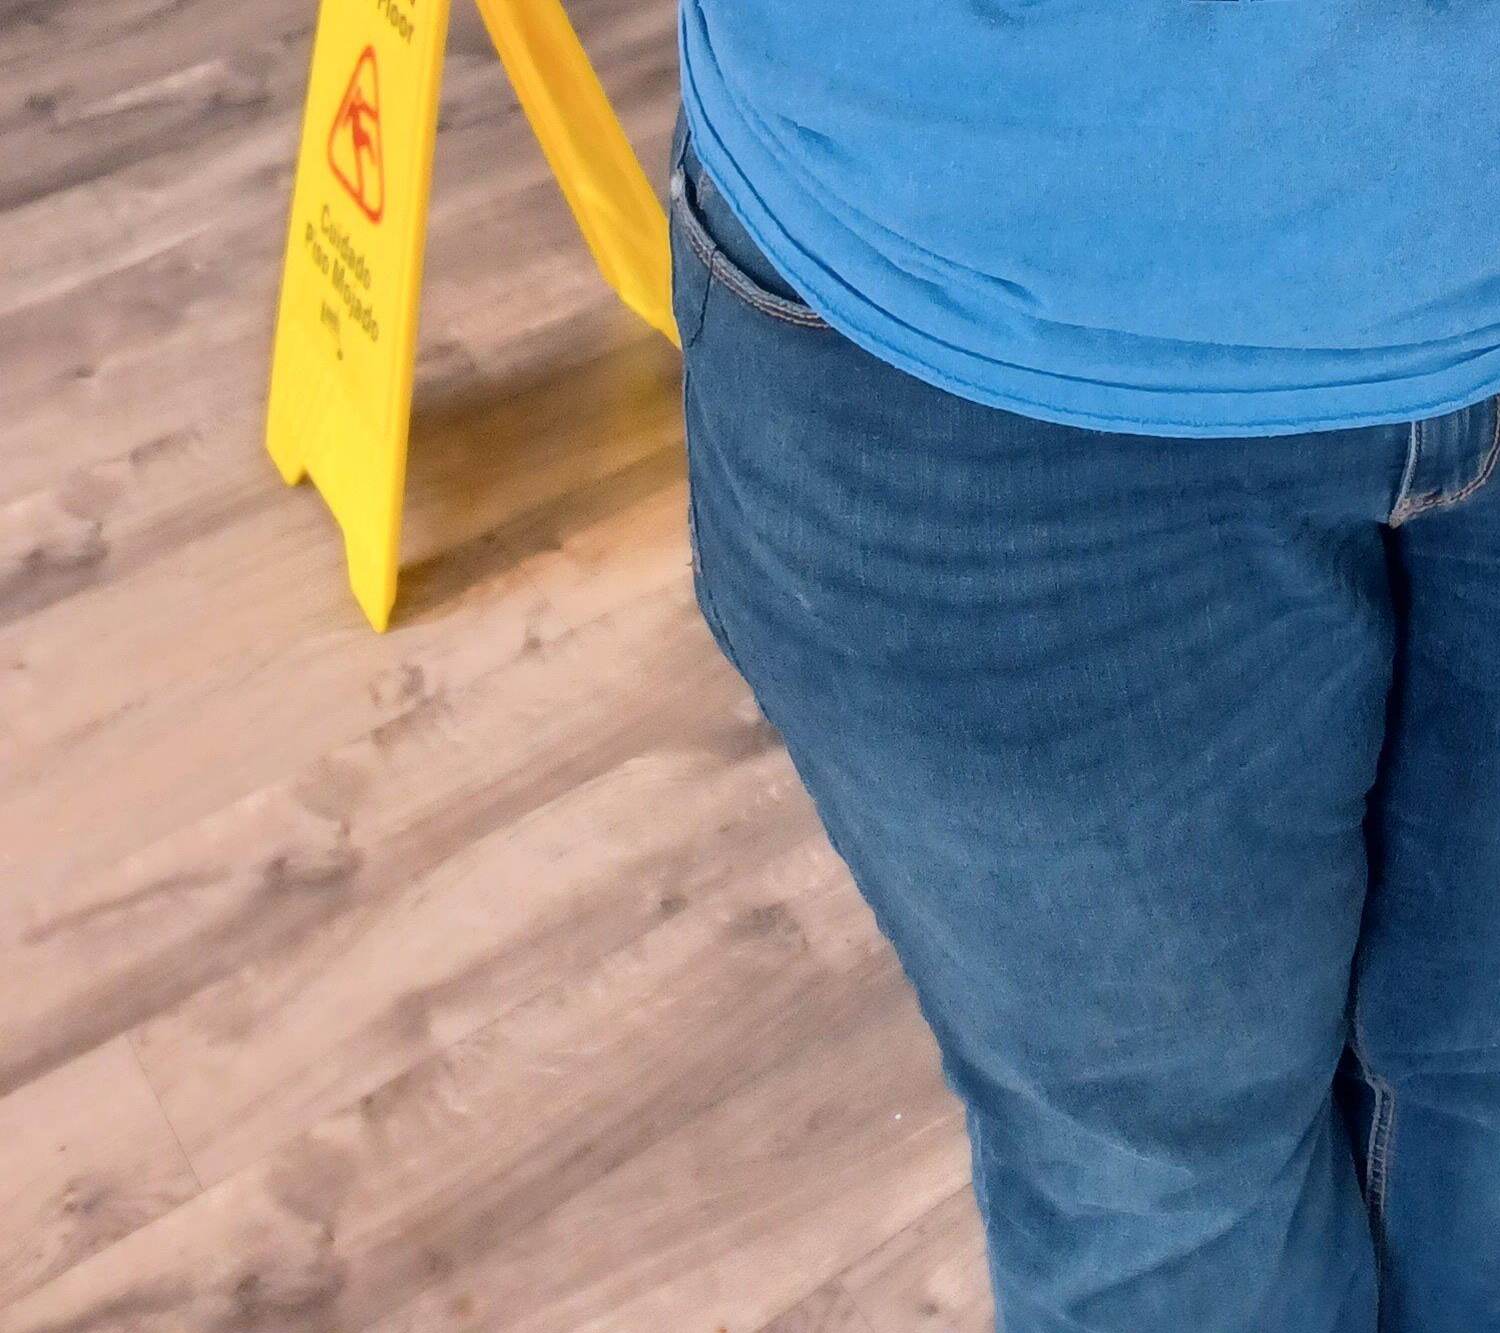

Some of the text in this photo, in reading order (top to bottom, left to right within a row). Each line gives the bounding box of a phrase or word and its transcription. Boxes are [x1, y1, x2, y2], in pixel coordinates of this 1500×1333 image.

[305, 222, 380, 342] Piso Mojado
[321, 204, 372, 291] Cuidado
